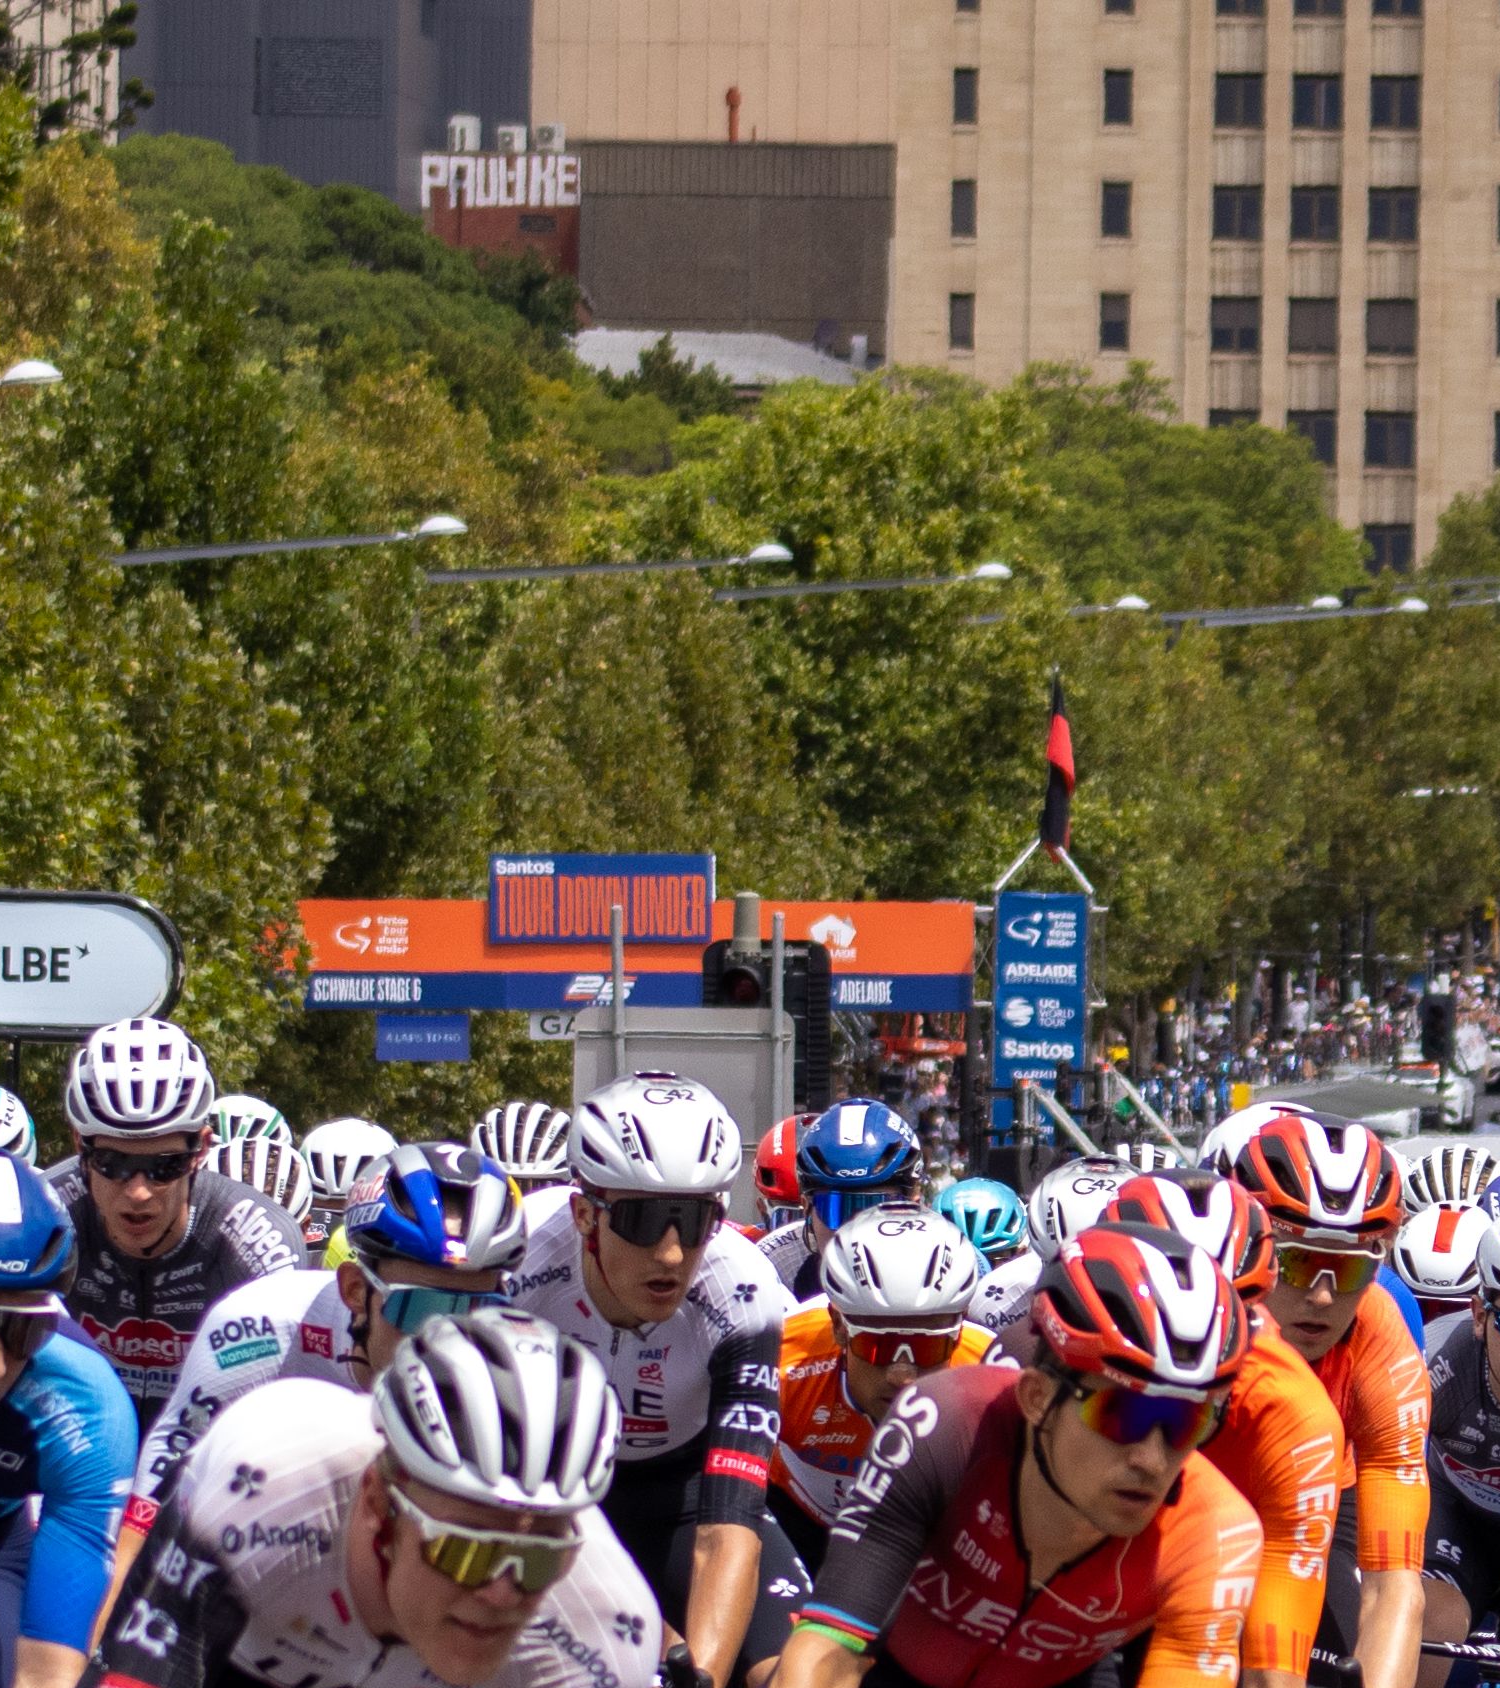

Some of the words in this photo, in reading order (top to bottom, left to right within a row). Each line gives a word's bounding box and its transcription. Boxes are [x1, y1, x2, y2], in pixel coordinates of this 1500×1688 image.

[496, 860, 554, 875] Santos
[496, 876, 553, 937] TOUR
[558, 876, 628, 937] DOWN
[634, 876, 706, 937] UNDER
[1006, 964, 1076, 978] ADELAIDE
[313, 979, 375, 1002] SCHWALBE
[377, 980, 411, 1001] STAGE
[413, 979, 421, 1001] 6
[839, 980, 892, 1004] ADELAIDE
[1039, 1000, 1059, 1010] UCI
[1039, 1009, 1075, 1020] WORLD
[1039, 1017, 1066, 1028] TOUR
[1004, 1040, 1075, 1060] Santos
[644, 1088, 695, 1104] G42
[618, 1112, 644, 1164] MET
[710, 1118, 726, 1167] MET
[878, 1221, 926, 1236] G42
[521, 1264, 572, 1291] Analog
[851, 1242, 870, 1289] MET
[934, 1244, 954, 1291] MET
[209, 1316, 276, 1350] BORA
[217, 1341, 279, 1365] hansgrohe
[786, 1358, 837, 1380] Santos
[407, 1364, 450, 1439] MET
[1388, 1355, 1428, 1486] INEOS
[712, 1454, 767, 1480] Emirates
[831, 1387, 939, 1542] INEOS
[1288, 1432, 1335, 1580] INEOS
[953, 1530, 1002, 1582] GOBIK
[1196, 1523, 1261, 1679] INEOS
